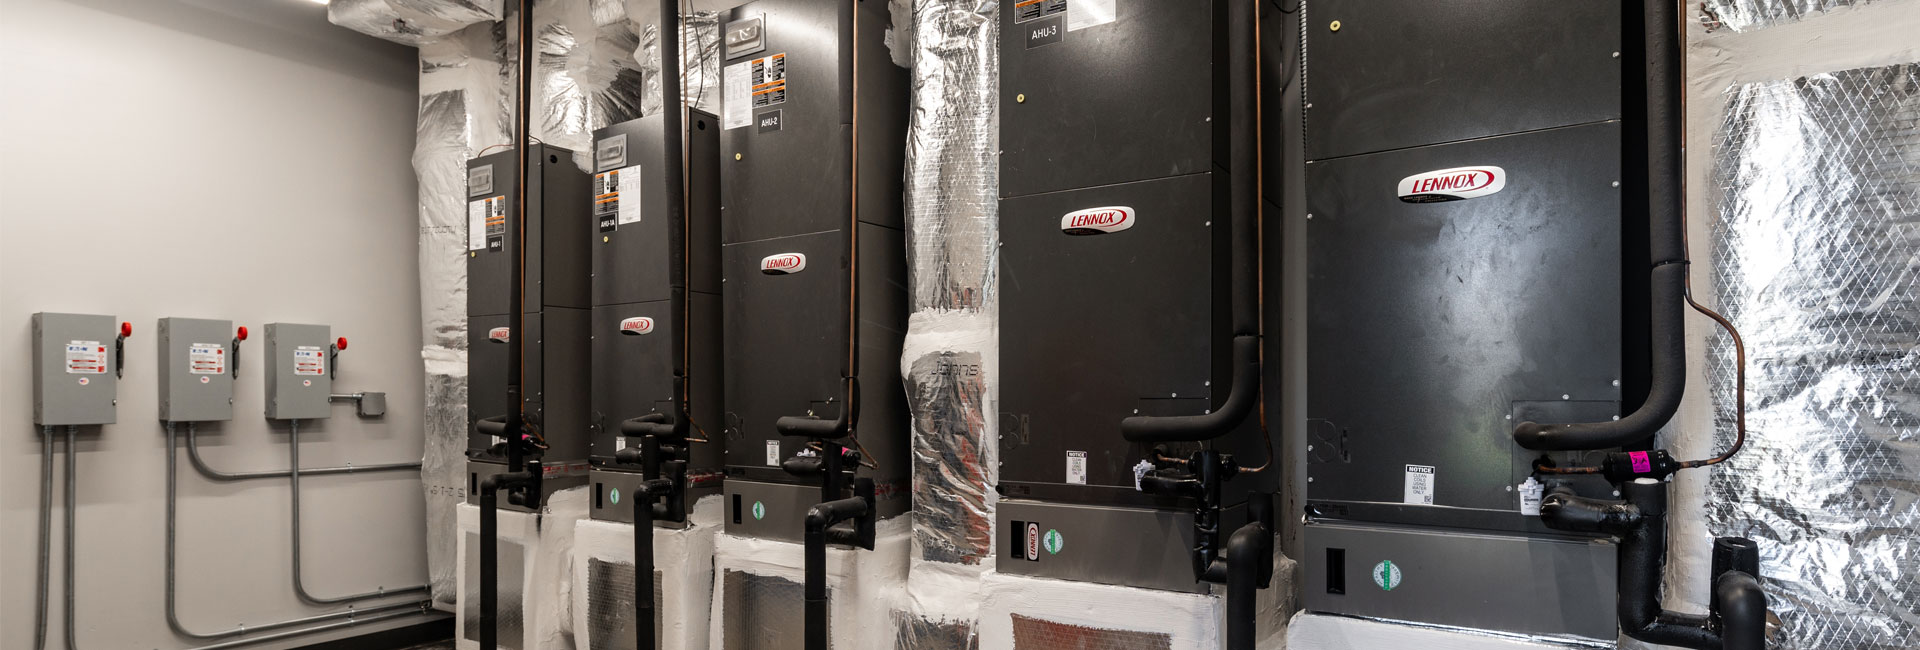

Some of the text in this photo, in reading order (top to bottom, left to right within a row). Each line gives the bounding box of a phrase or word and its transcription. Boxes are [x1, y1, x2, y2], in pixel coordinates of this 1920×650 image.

[1031, 25, 1057, 40] AHU-3
[761, 117, 778, 128] AHU-2
[1411, 173, 1478, 194] LENNOX
[1070, 212, 1116, 227] LENNOX
[766, 257, 794, 269] LENNOX
[624, 320, 645, 330] LENNOX
